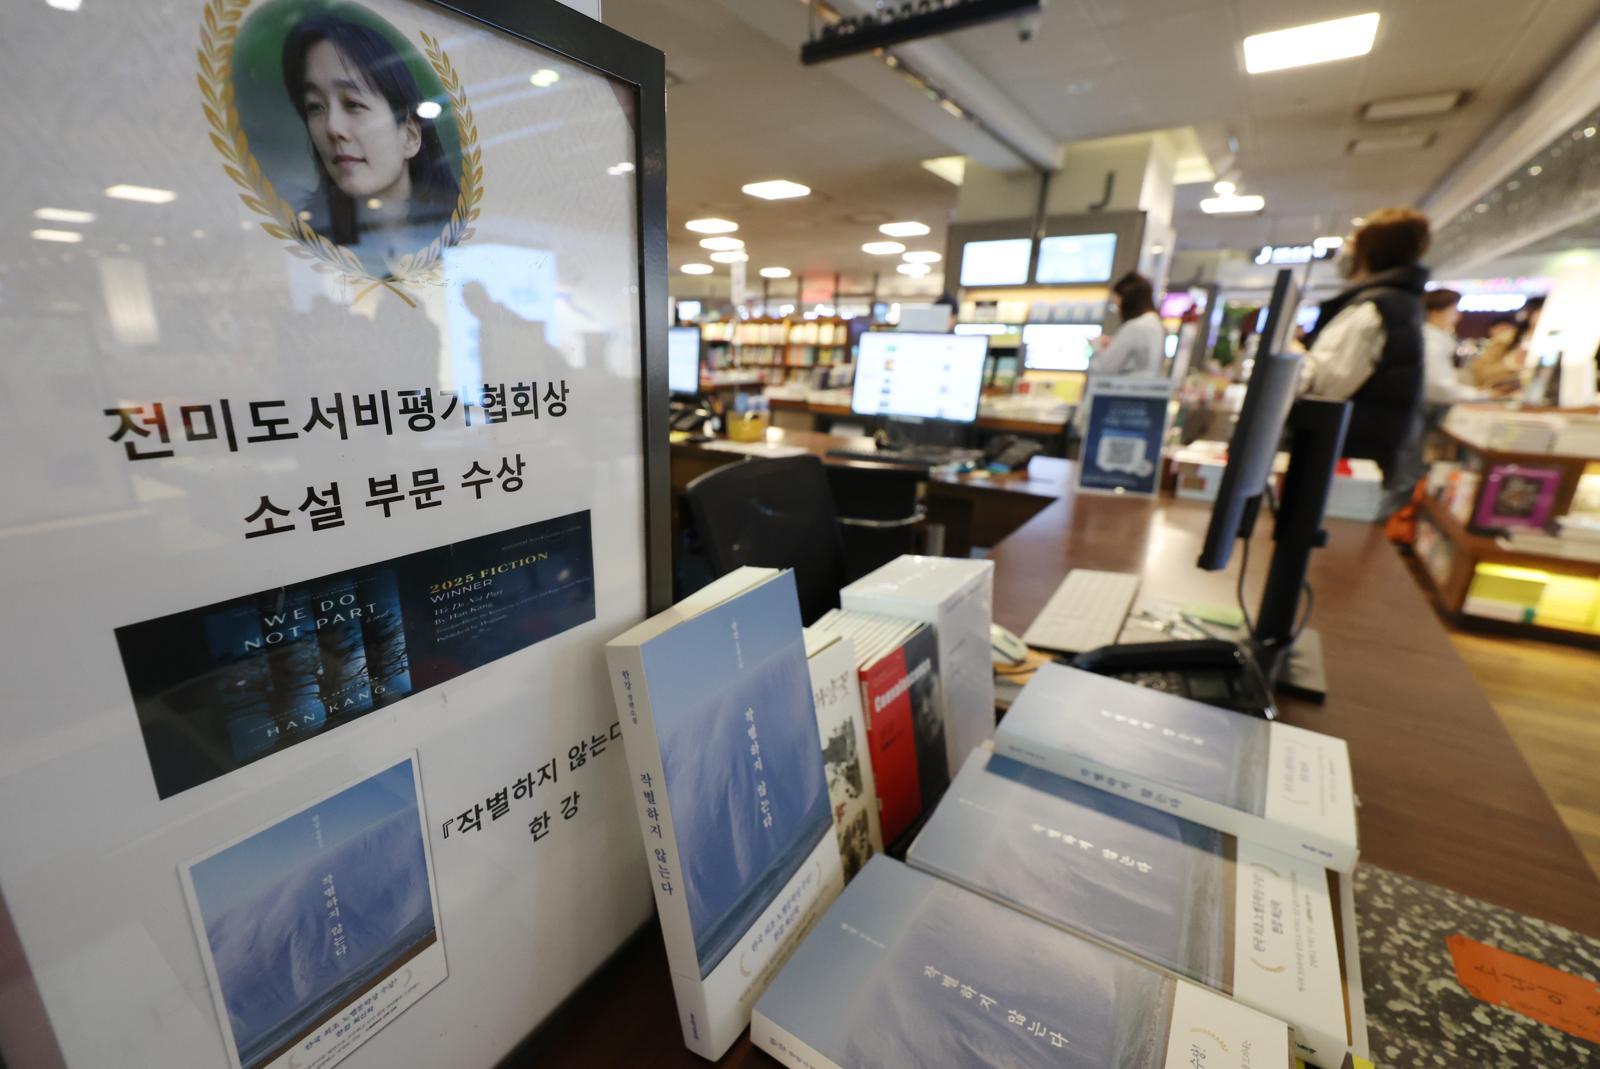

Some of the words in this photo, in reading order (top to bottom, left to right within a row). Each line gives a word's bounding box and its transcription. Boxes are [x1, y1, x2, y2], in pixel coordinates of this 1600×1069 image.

[103, 380, 570, 461] 전미도서비평가협회상
[244, 482, 346, 539] 소설
[365, 468, 445, 518] 부문
[461, 454, 526, 499] 수상
[430, 573, 475, 594] 2025
[480, 552, 549, 579] FICTION
[430, 579, 493, 603] WINNER
[244, 625, 301, 651] NOT
[316, 603, 377, 630] PART
[264, 607, 307, 627] WE
[320, 594, 355, 612] DO
[267, 713, 316, 737] HAN
[329, 685, 386, 713] KANG
[529, 811, 552, 843] 한
[560, 791, 581, 820] 강
[641, 772, 663, 839] 작별하지
[654, 848, 674, 896] 않는다
[922, 964, 998, 1012] 작별하지
[1006, 1008, 1070, 1049] 않는다
